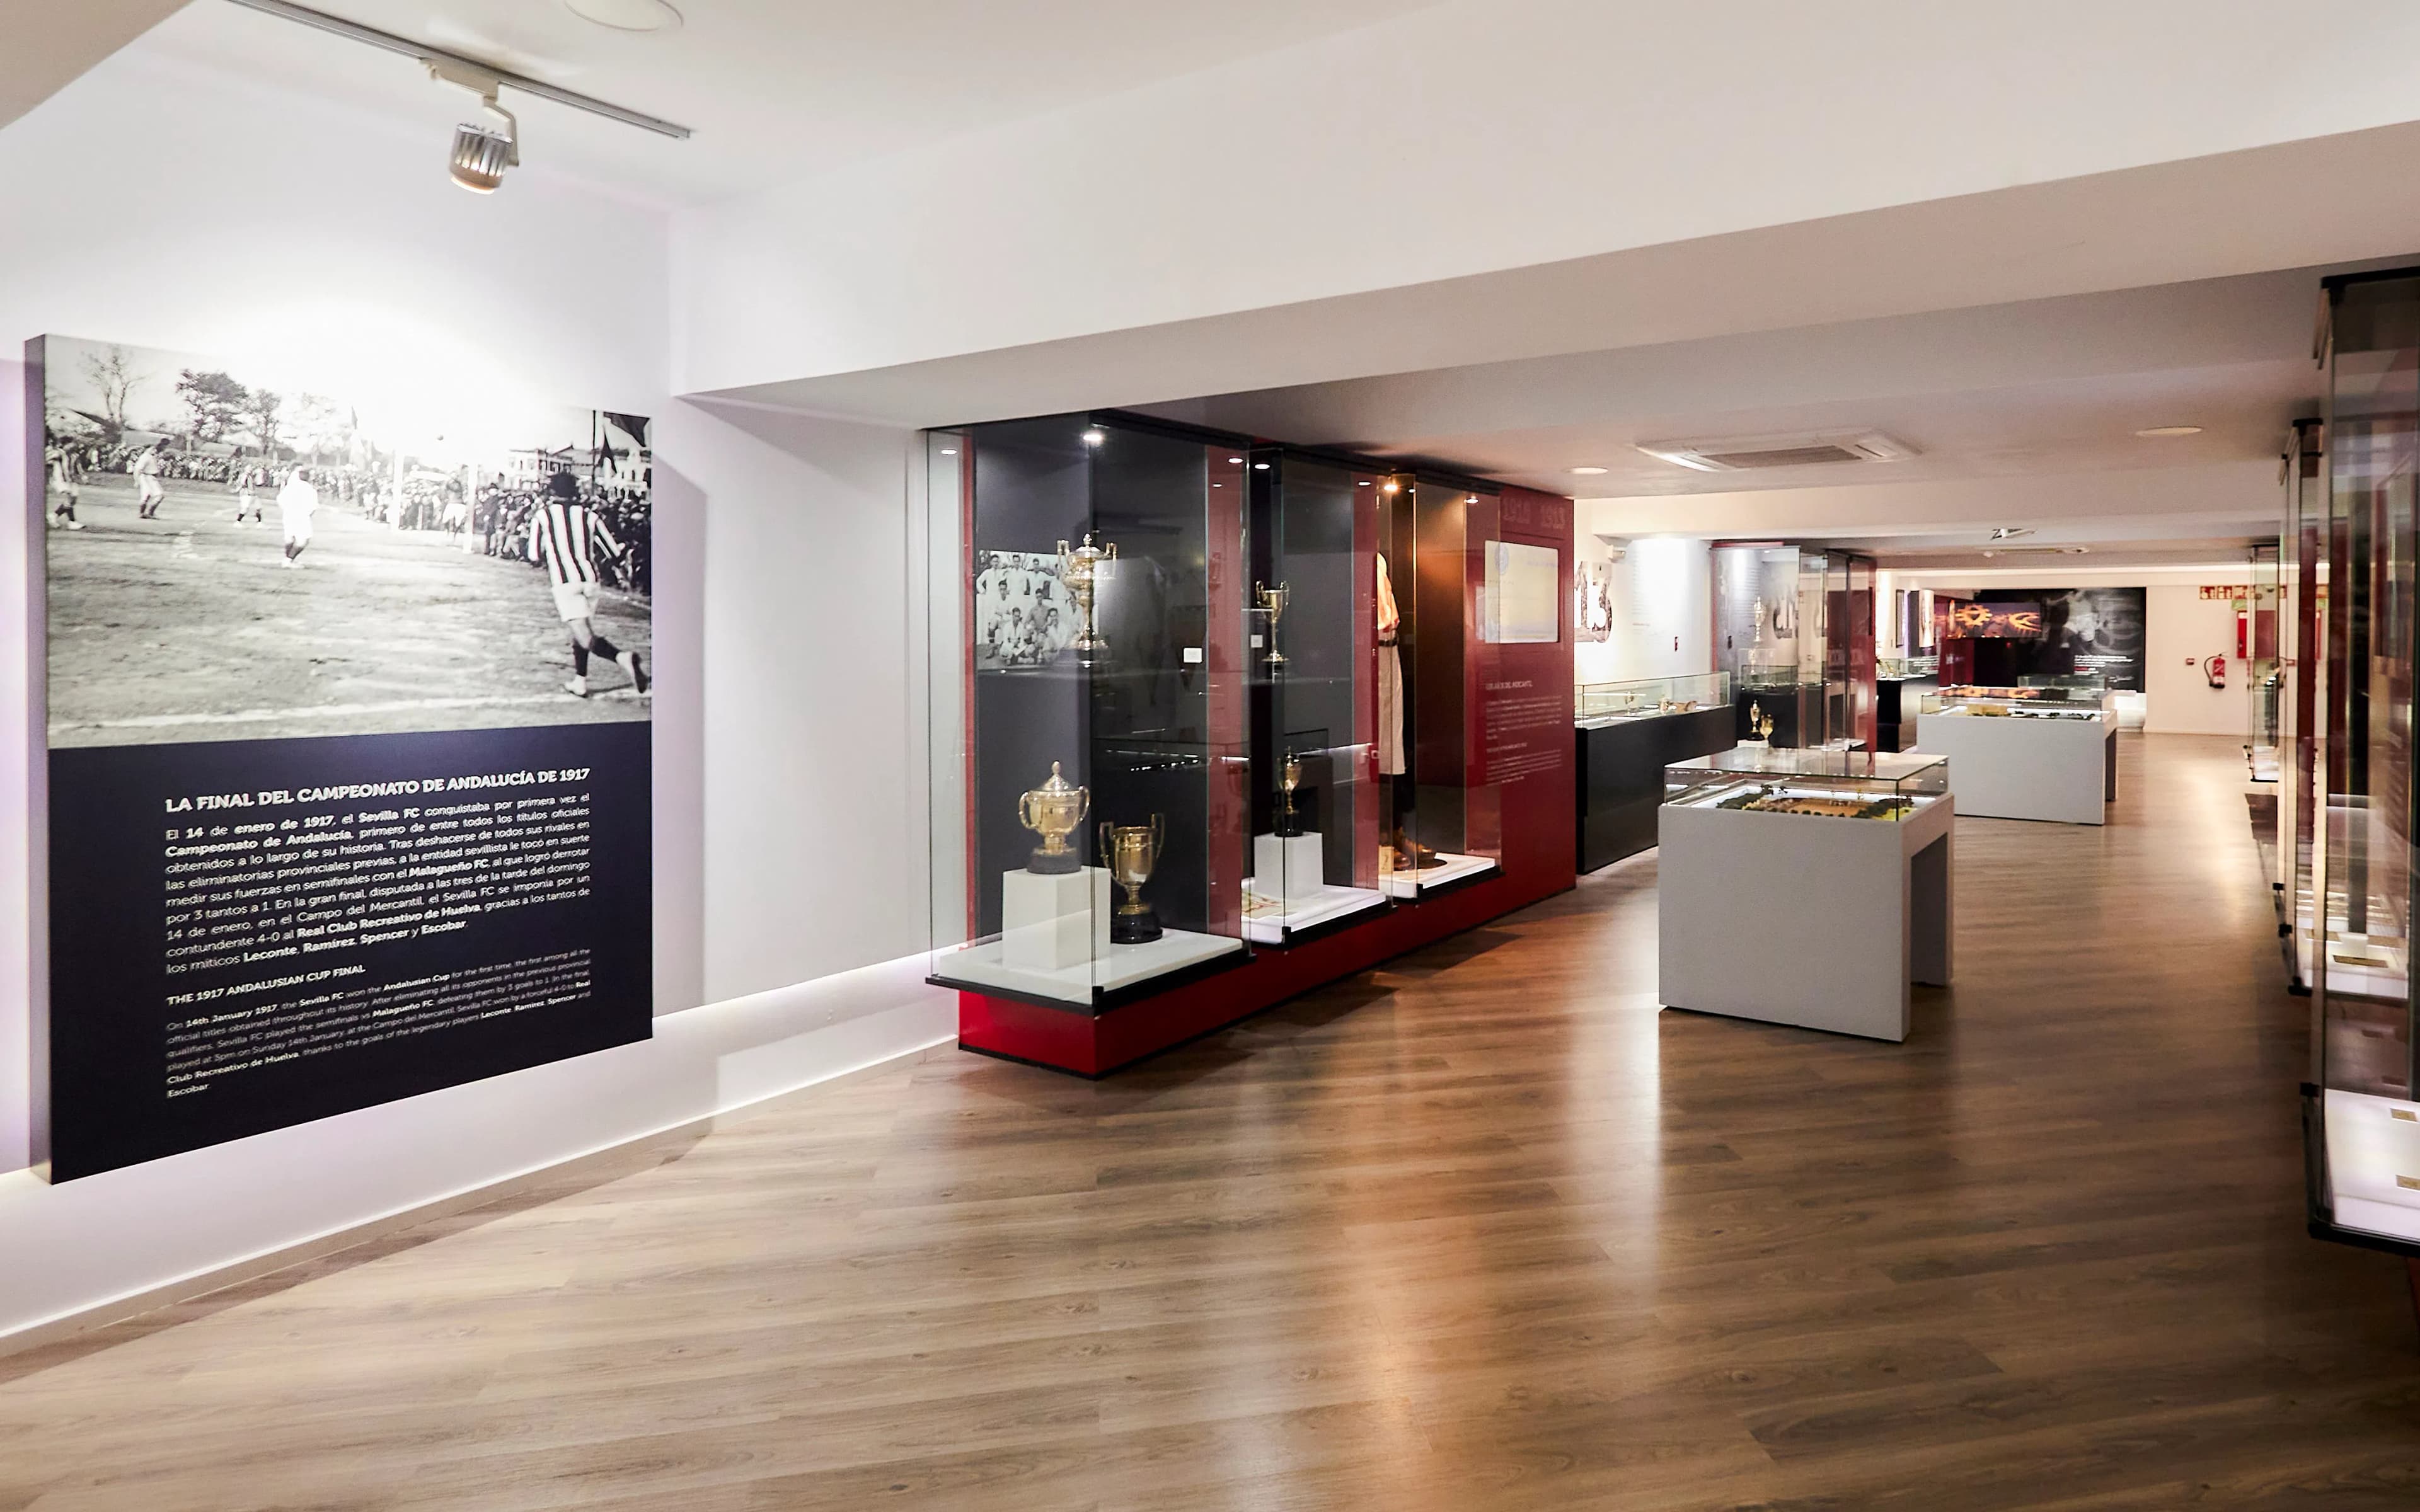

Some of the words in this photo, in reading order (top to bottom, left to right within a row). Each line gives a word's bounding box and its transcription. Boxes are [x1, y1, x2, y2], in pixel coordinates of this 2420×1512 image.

[165, 797, 193, 813] LA
[196, 793, 255, 811] FINAL
[257, 789, 295, 806] DEL
[296, 780, 420, 803] CAMPEONATO
[422, 778, 445, 793] DE
[446, 769, 536, 791] ANDALUCÍA
[537, 770, 558, 784] DE
[559, 767, 591, 782] 1917
[164, 839, 259, 858] Campeonato
[262, 836, 282, 848] de
[359, 825, 406, 840] primero
[409, 822, 426, 833] de
[429, 820, 459, 832] entre
[462, 816, 493, 828] todos
[497, 814, 513, 825] los
[550, 806, 591, 820] oficiales
[165, 828, 179, 841] El
[185, 827, 204, 840] 14
[209, 825, 229, 837] de
[233, 822, 276, 835] enero
[280, 818, 299, 831] de
[341, 813, 354, 825] el
[358, 810, 400, 823] Sevilla
[403, 807, 420, 820] FC
[424, 801, 491, 818] conquistaba
[493, 801, 514, 813] por
[516, 797, 556, 810] primera
[558, 795, 577, 805] vez
[580, 792, 590, 803] el
[165, 858, 235, 874] obtenidos
[237, 857, 247, 867] a
[249, 854, 264, 866] lo
[266, 851, 300, 864] largo
[301, 848, 320, 860] de
[321, 847, 337, 858] su
[388, 839, 413, 850] Tras
[415, 832, 477, 848] deshacerse
[477, 830, 493, 841] de
[493, 827, 524, 839] todos
[525, 825, 543, 836] sus
[544, 822, 576, 833] rivales
[576, 821, 591, 830] en
[165, 880, 186, 891] las
[187, 869, 275, 889] eliminatorias
[276, 861, 352, 881] provinciales
[398, 855, 408, 865] a
[408, 852, 420, 863] la
[420, 847, 463, 862] entidad
[464, 843, 509, 857] sevillista
[509, 841, 520, 852] le
[521, 838, 544, 850] tocó
[545, 838, 559, 847] en
[560, 834, 591, 846] suerte
[166, 893, 207, 908] medir
[209, 891, 233, 902] sus
[234, 885, 282, 899] fuerzas
[283, 883, 301, 893] en
[302, 874, 371, 891] semifinales
[371, 871, 395, 883] con
[395, 868, 408, 879] el
[408, 861, 473, 878] Malagueño
[492, 856, 502, 868] al
[502, 856, 524, 868] que
[524, 851, 551, 864] logró
[551, 848, 590, 861] derrotar
[166, 913, 191, 926] por
[193, 909, 203, 921] 3
[205, 905, 248, 920] tantos
[250, 904, 259, 914] a
[275, 898, 292, 910] En
[294, 896, 306, 908] la
[307, 894, 337, 908] gran
[368, 881, 425, 898] disputada
[425, 881, 435, 891] a
[435, 878, 452, 890] las
[452, 876, 474, 887] tres
[474, 873, 489, 884] de
[490, 871, 501, 882] la
[501, 868, 529, 880] tarde
[529, 865, 546, 877] del
[546, 861, 591, 874] domingo
[166, 937, 255, 957] contundente
[256, 931, 280, 943] 4-0
[282, 929, 295, 941] al
[296, 924, 325, 939] Real
[326, 920, 358, 934] Club
[359, 912, 424, 930] Recreativo
[424, 908, 440, 920] de
[483, 898, 521, 913] gracias
[522, 896, 529, 905] a
[529, 894, 545, 903] los
[546, 890, 577, 902] tantos
[577, 887, 591, 897] de
[167, 929, 183, 941] 14
[187, 926, 207, 937] de
[257, 918, 276, 929] en
[279, 914, 292, 925] el
[296, 908, 343, 924] Campo
[345, 903, 366, 917] del
[428, 893, 440, 905] el
[442, 889, 477, 903] Sevilla
[480, 886, 495, 897] FC
[497, 885, 510, 895] se
[556, 877, 574, 888] por
[576, 874, 591, 884] un
[166, 963, 187, 974] los
[359, 929, 410, 946] Spencer
[410, 927, 420, 939] y
[166, 993, 194, 1006] THE
[196, 987, 225, 1002] 1917
[226, 974, 305, 997] ANDALUSIAN
[305, 970, 331, 983] CUP
[332, 964, 366, 978] FINAL
[298, 995, 330, 1008] Sevilla
[331, 991, 345, 1001] FC
[383, 977, 432, 992] Andalusian
[431, 973, 451, 983] Cup
[166, 1073, 193, 1084] Club
[250, 1058, 263, 1068] de
